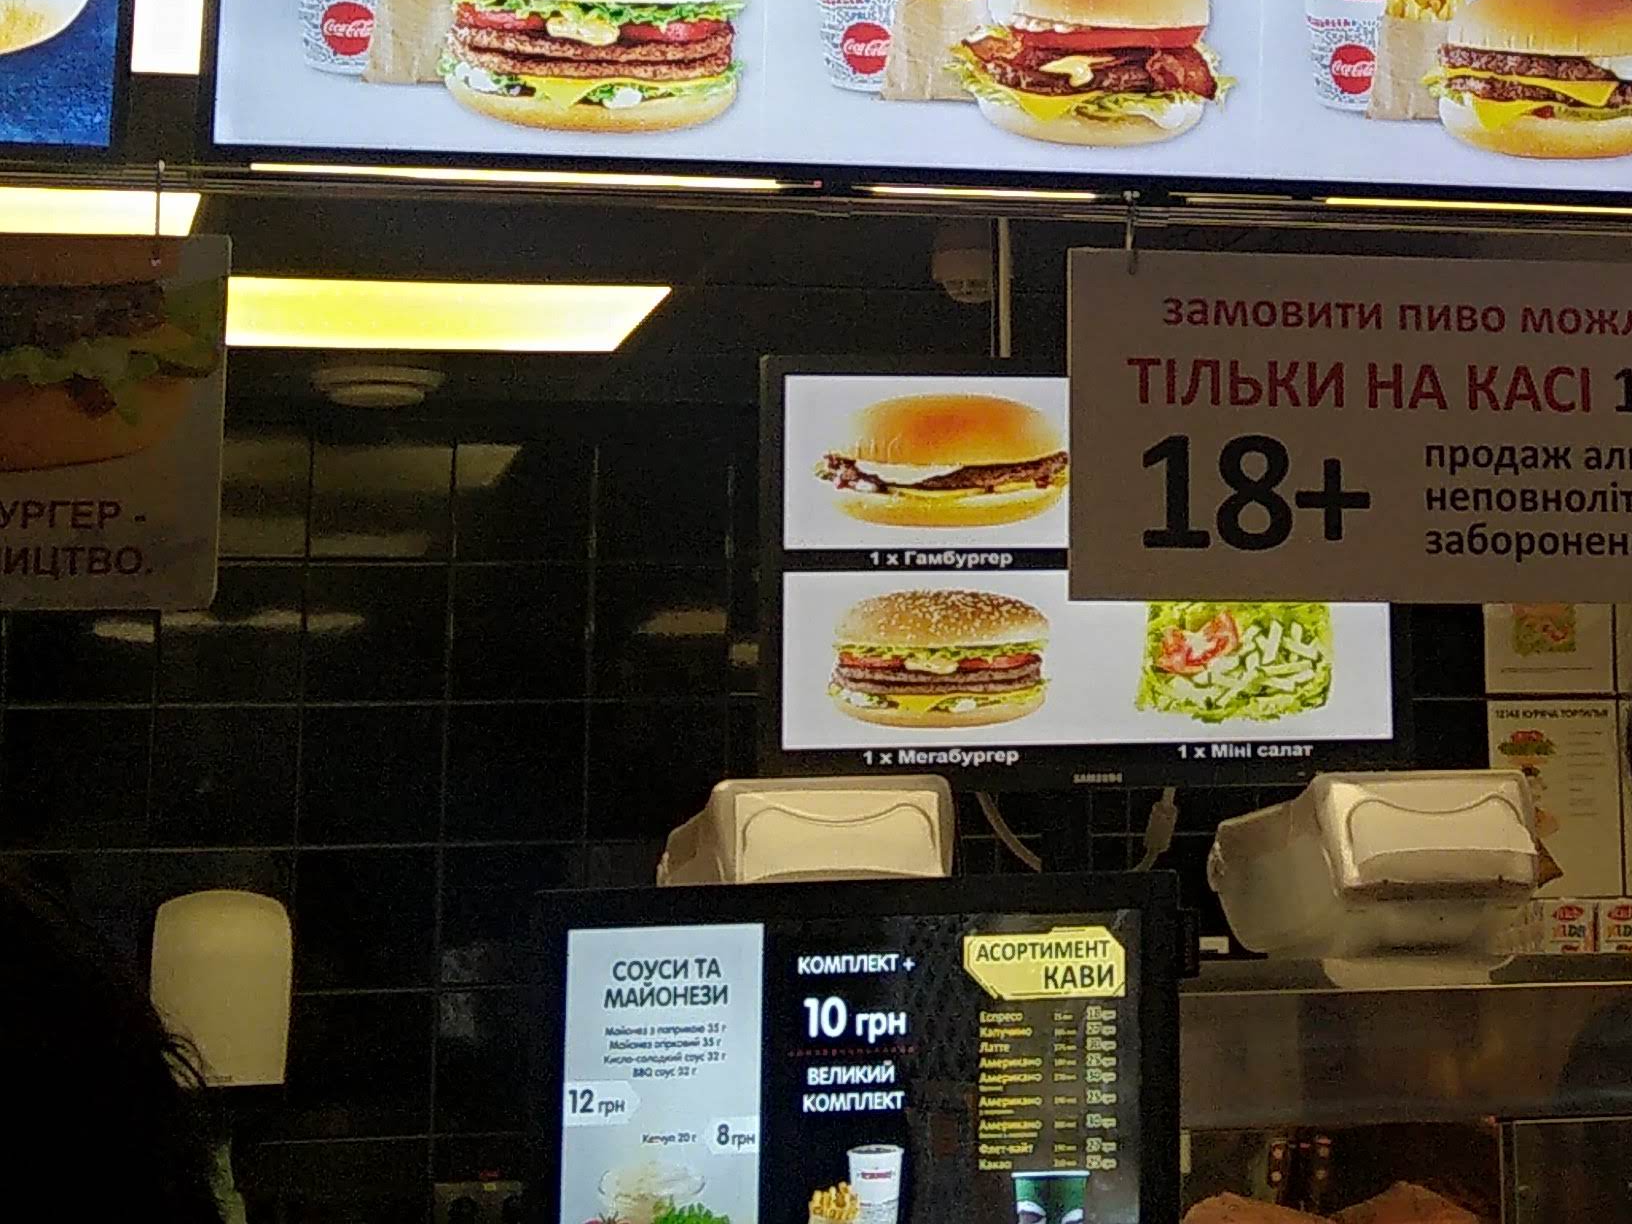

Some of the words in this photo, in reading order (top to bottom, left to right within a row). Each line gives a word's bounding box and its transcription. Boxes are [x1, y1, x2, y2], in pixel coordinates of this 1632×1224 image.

[1162, 296, 1382, 332] замовити
[1399, 300, 1505, 333] пиво
[1127, 356, 1345, 408] ТІЛЬКИ
[1366, 363, 1448, 411] НА
[1467, 367, 1591, 413] КАСІ
[1426, 442, 1571, 474] продаж
[1142, 433, 1371, 551] 18+
[905, 551, 1013, 569] Гамбургер
[898, 748, 1019, 767] Мегабургер
[1211, 743, 1252, 758] Міні
[1257, 744, 1313, 759] салат
[976, 940, 1110, 961] АСОРТИМЕНТ
[613, 959, 689, 982] СОУСИ
[695, 958, 722, 978] ТА
[798, 953, 899, 975] КОМПЛЕКТ
[1044, 965, 1114, 990] КАВИ
[604, 983, 728, 1009] МАЙОНЕЗИ
[804, 997, 846, 1038] 10
[855, 1009, 907, 1043] грн
[807, 1060, 895, 1085] ВЕЛИКИЙ
[803, 1090, 905, 1112] КОМПЛЕКТ
